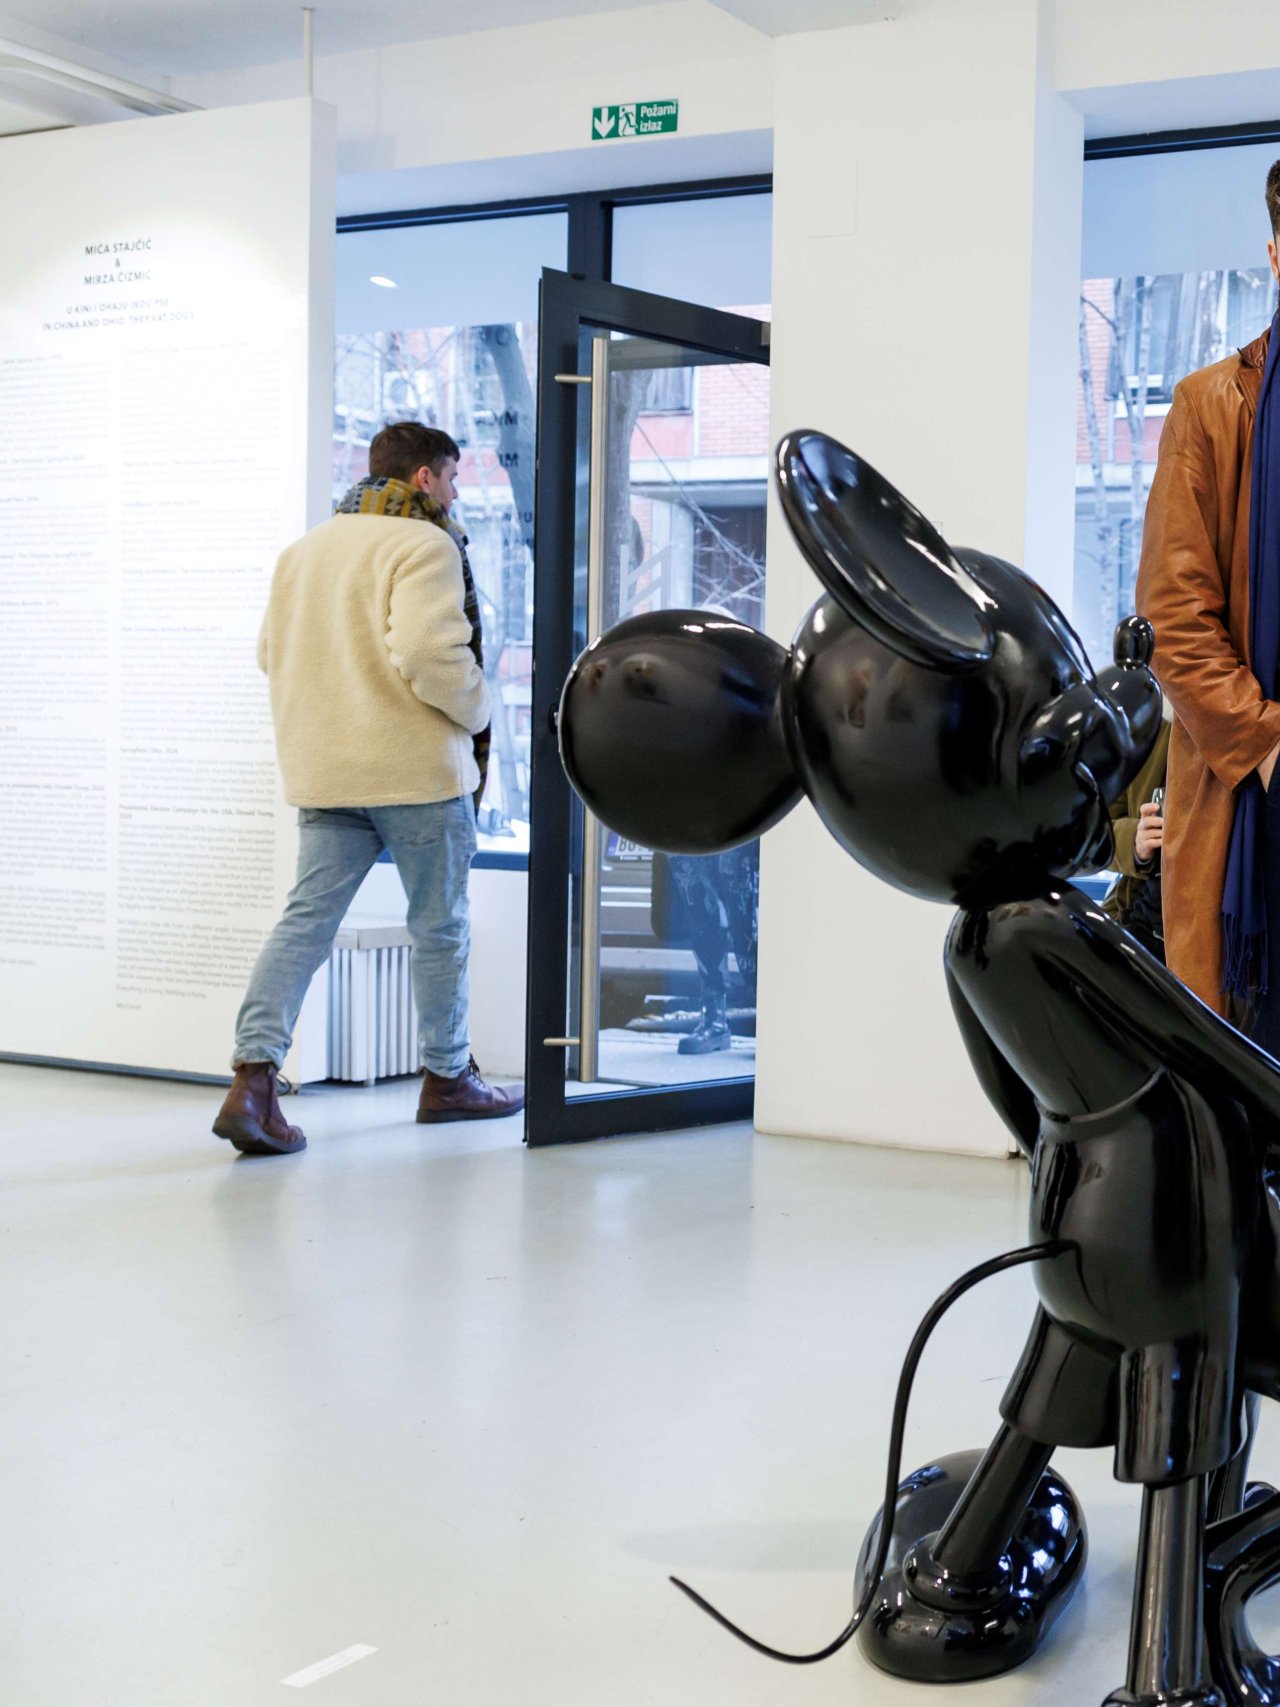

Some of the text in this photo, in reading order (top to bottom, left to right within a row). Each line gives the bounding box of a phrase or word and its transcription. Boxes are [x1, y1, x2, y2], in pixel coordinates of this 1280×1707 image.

[641, 102, 676, 118] Požarni
[640, 120, 662, 132] izlaz
[114, 258, 121, 268] &
[84, 274, 115, 285] MIRZA
